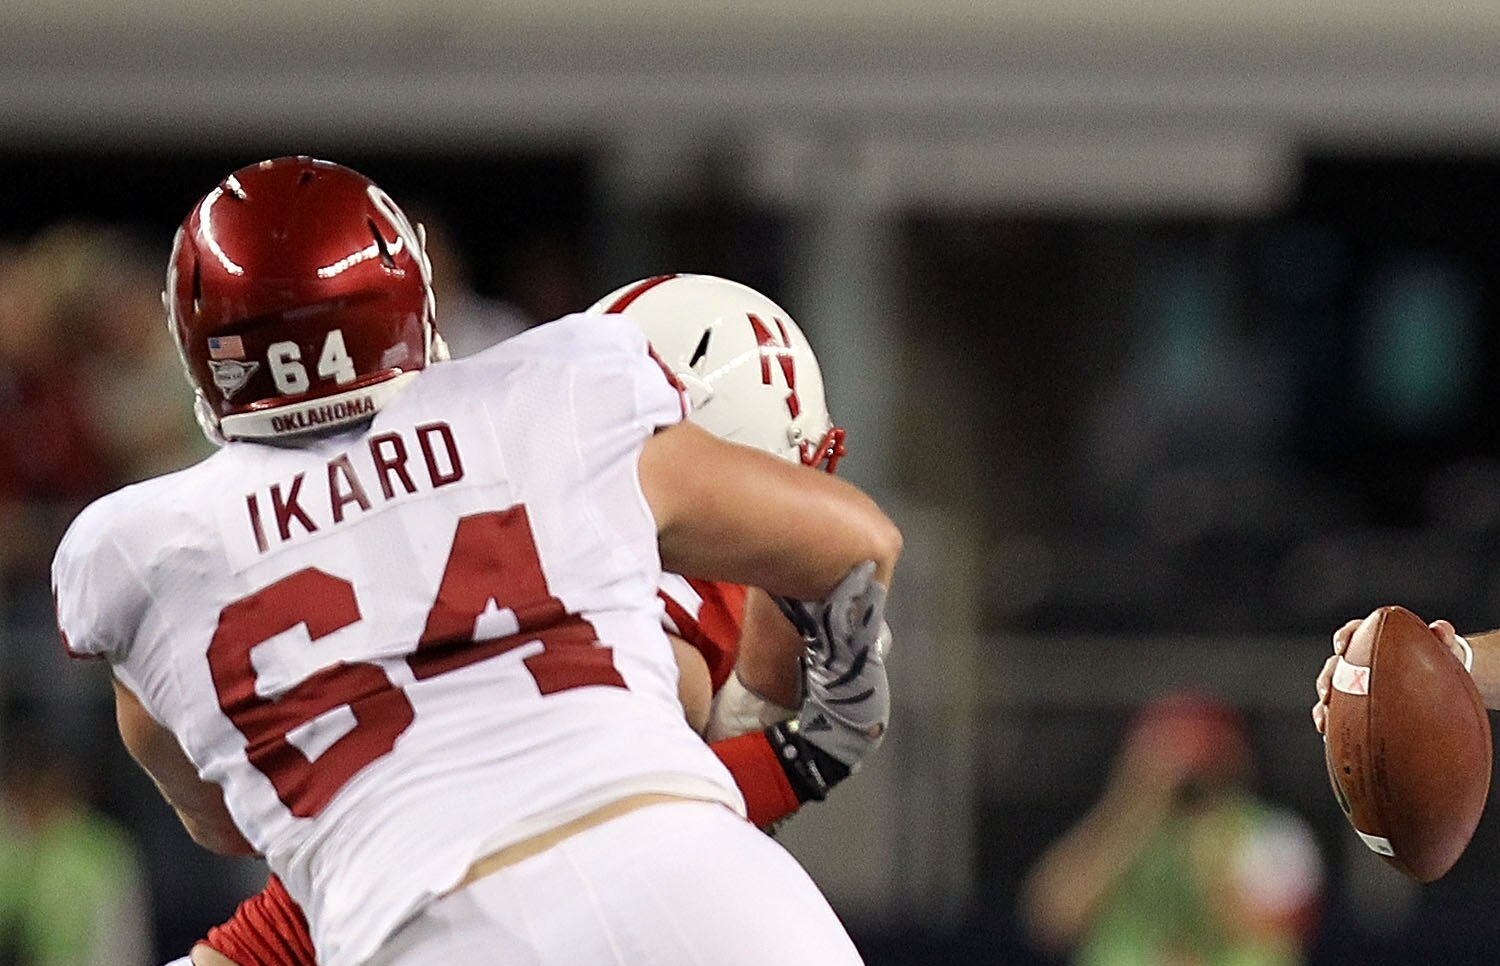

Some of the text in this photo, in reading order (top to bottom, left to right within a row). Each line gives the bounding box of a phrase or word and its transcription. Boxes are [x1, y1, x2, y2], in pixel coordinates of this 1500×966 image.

[267, 328, 357, 395] 64
[272, 396, 376, 433] OKLAHOMA
[245, 420, 465, 555] IKARD
[207, 503, 629, 818] 64
